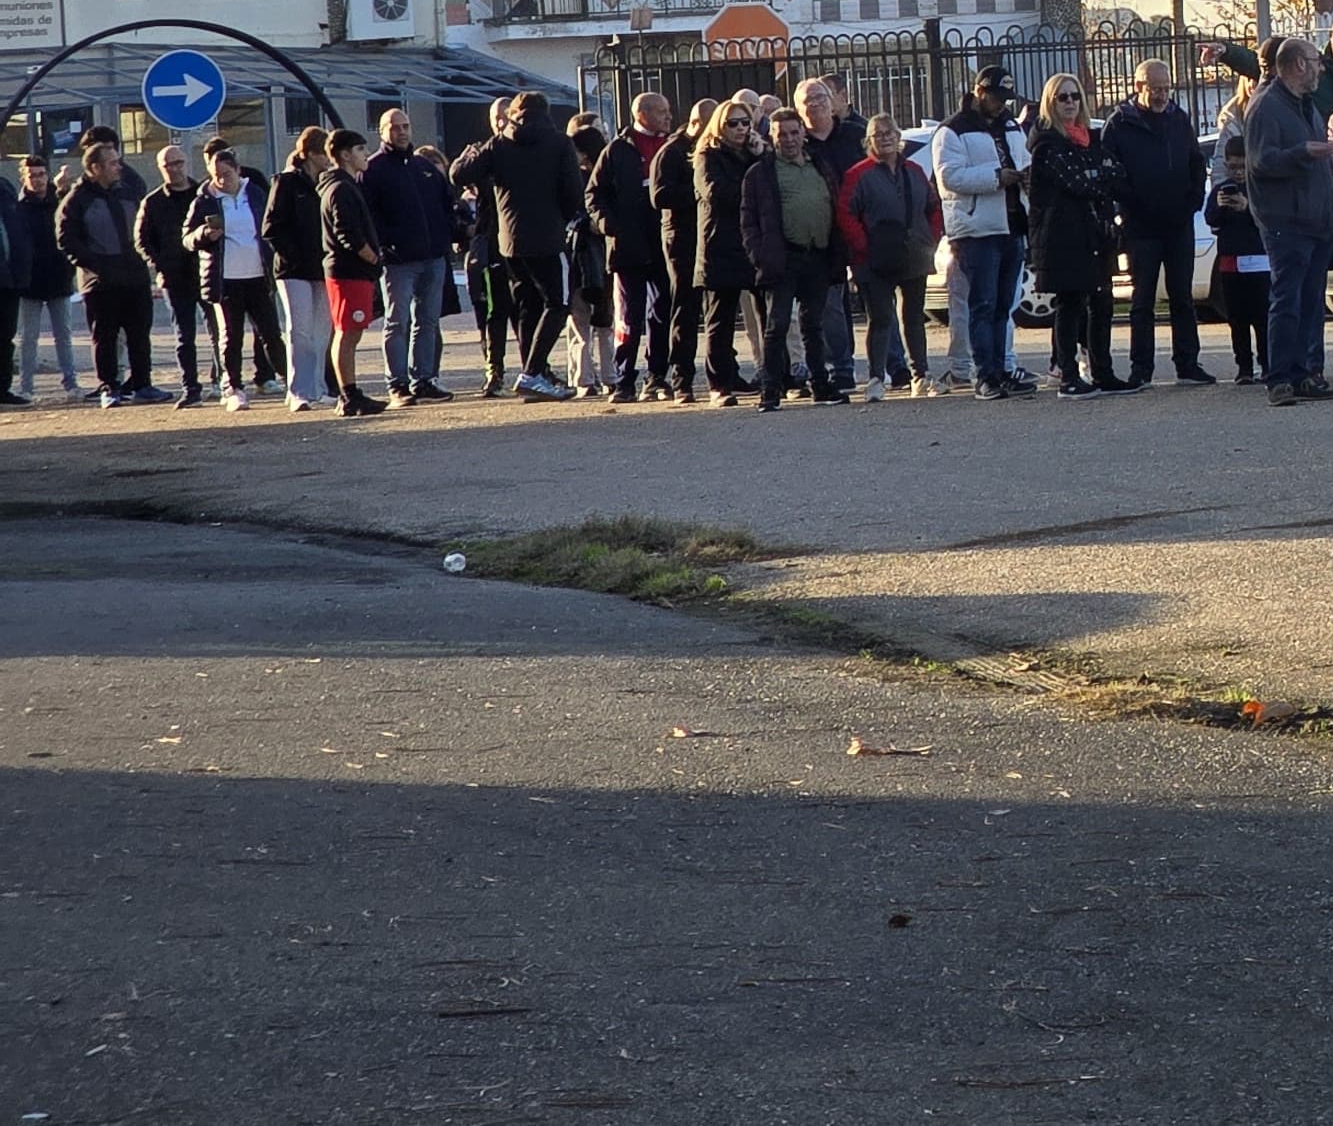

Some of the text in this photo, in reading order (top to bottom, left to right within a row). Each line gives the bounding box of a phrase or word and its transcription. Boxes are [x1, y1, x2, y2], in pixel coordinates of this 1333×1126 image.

[0, 0, 53, 11] muniones
[0, 14, 52, 25] midas de
[0, 28, 48, 40] mpresas
